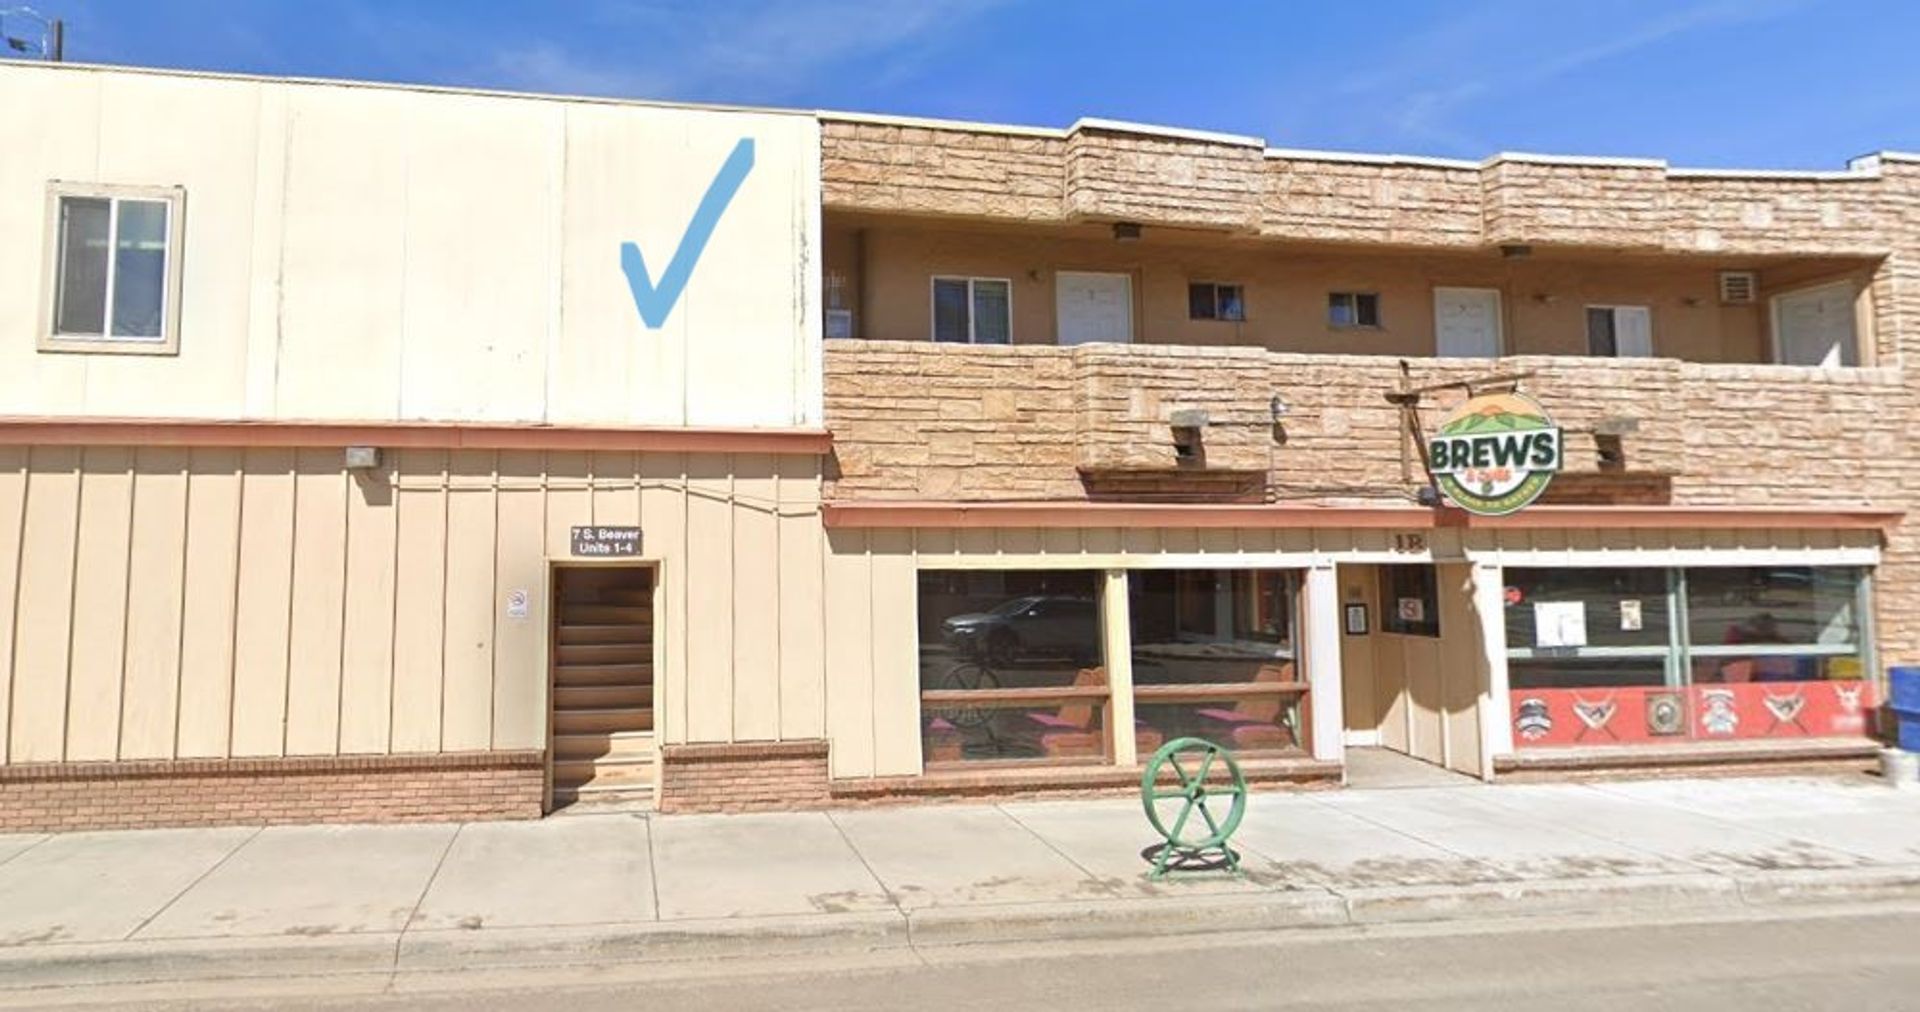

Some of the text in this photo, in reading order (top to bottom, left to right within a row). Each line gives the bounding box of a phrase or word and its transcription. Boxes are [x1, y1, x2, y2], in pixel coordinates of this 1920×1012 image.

[1430, 432, 1555, 469] BREWS
[572, 528, 640, 540] 7 S. Beaver
[579, 542, 633, 554] Units 1-4
